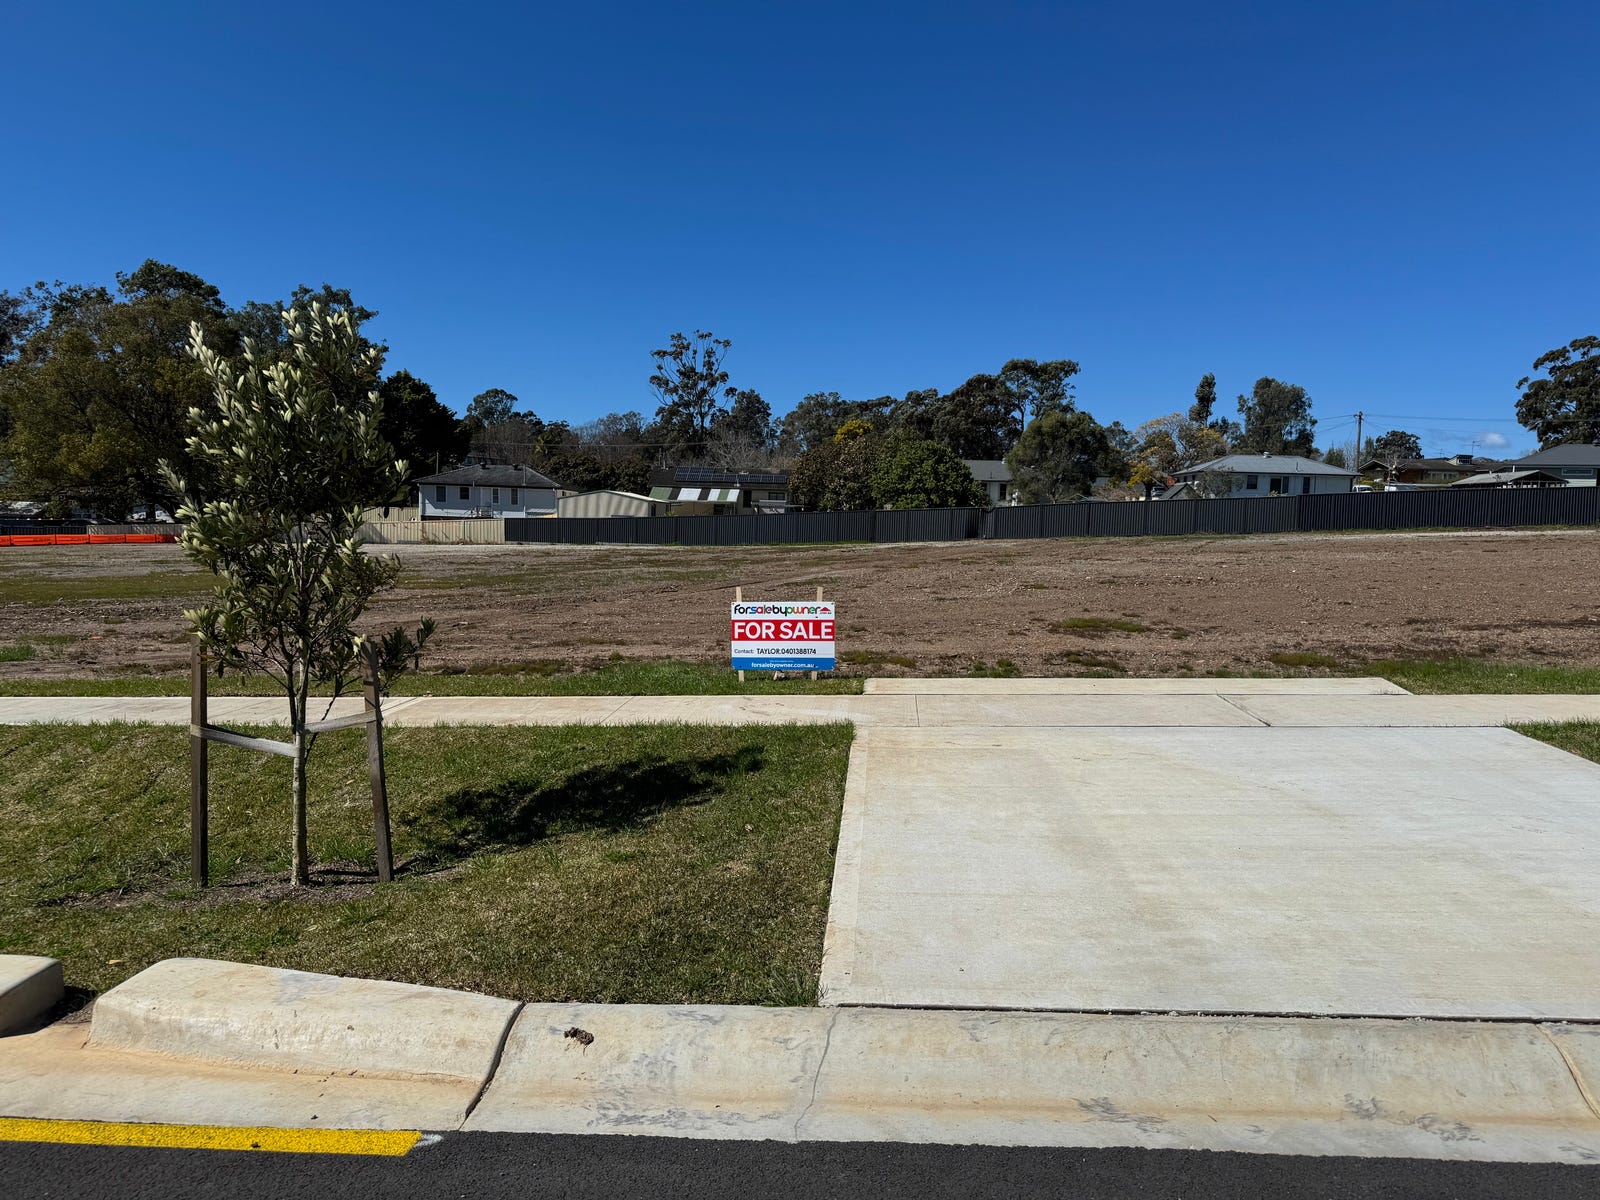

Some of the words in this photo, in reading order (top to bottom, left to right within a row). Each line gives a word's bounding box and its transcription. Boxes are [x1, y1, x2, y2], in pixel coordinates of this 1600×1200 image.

[735, 604, 820, 616] forsalebyowner
[735, 622, 775, 639] FOR
[779, 622, 833, 639] SALE
